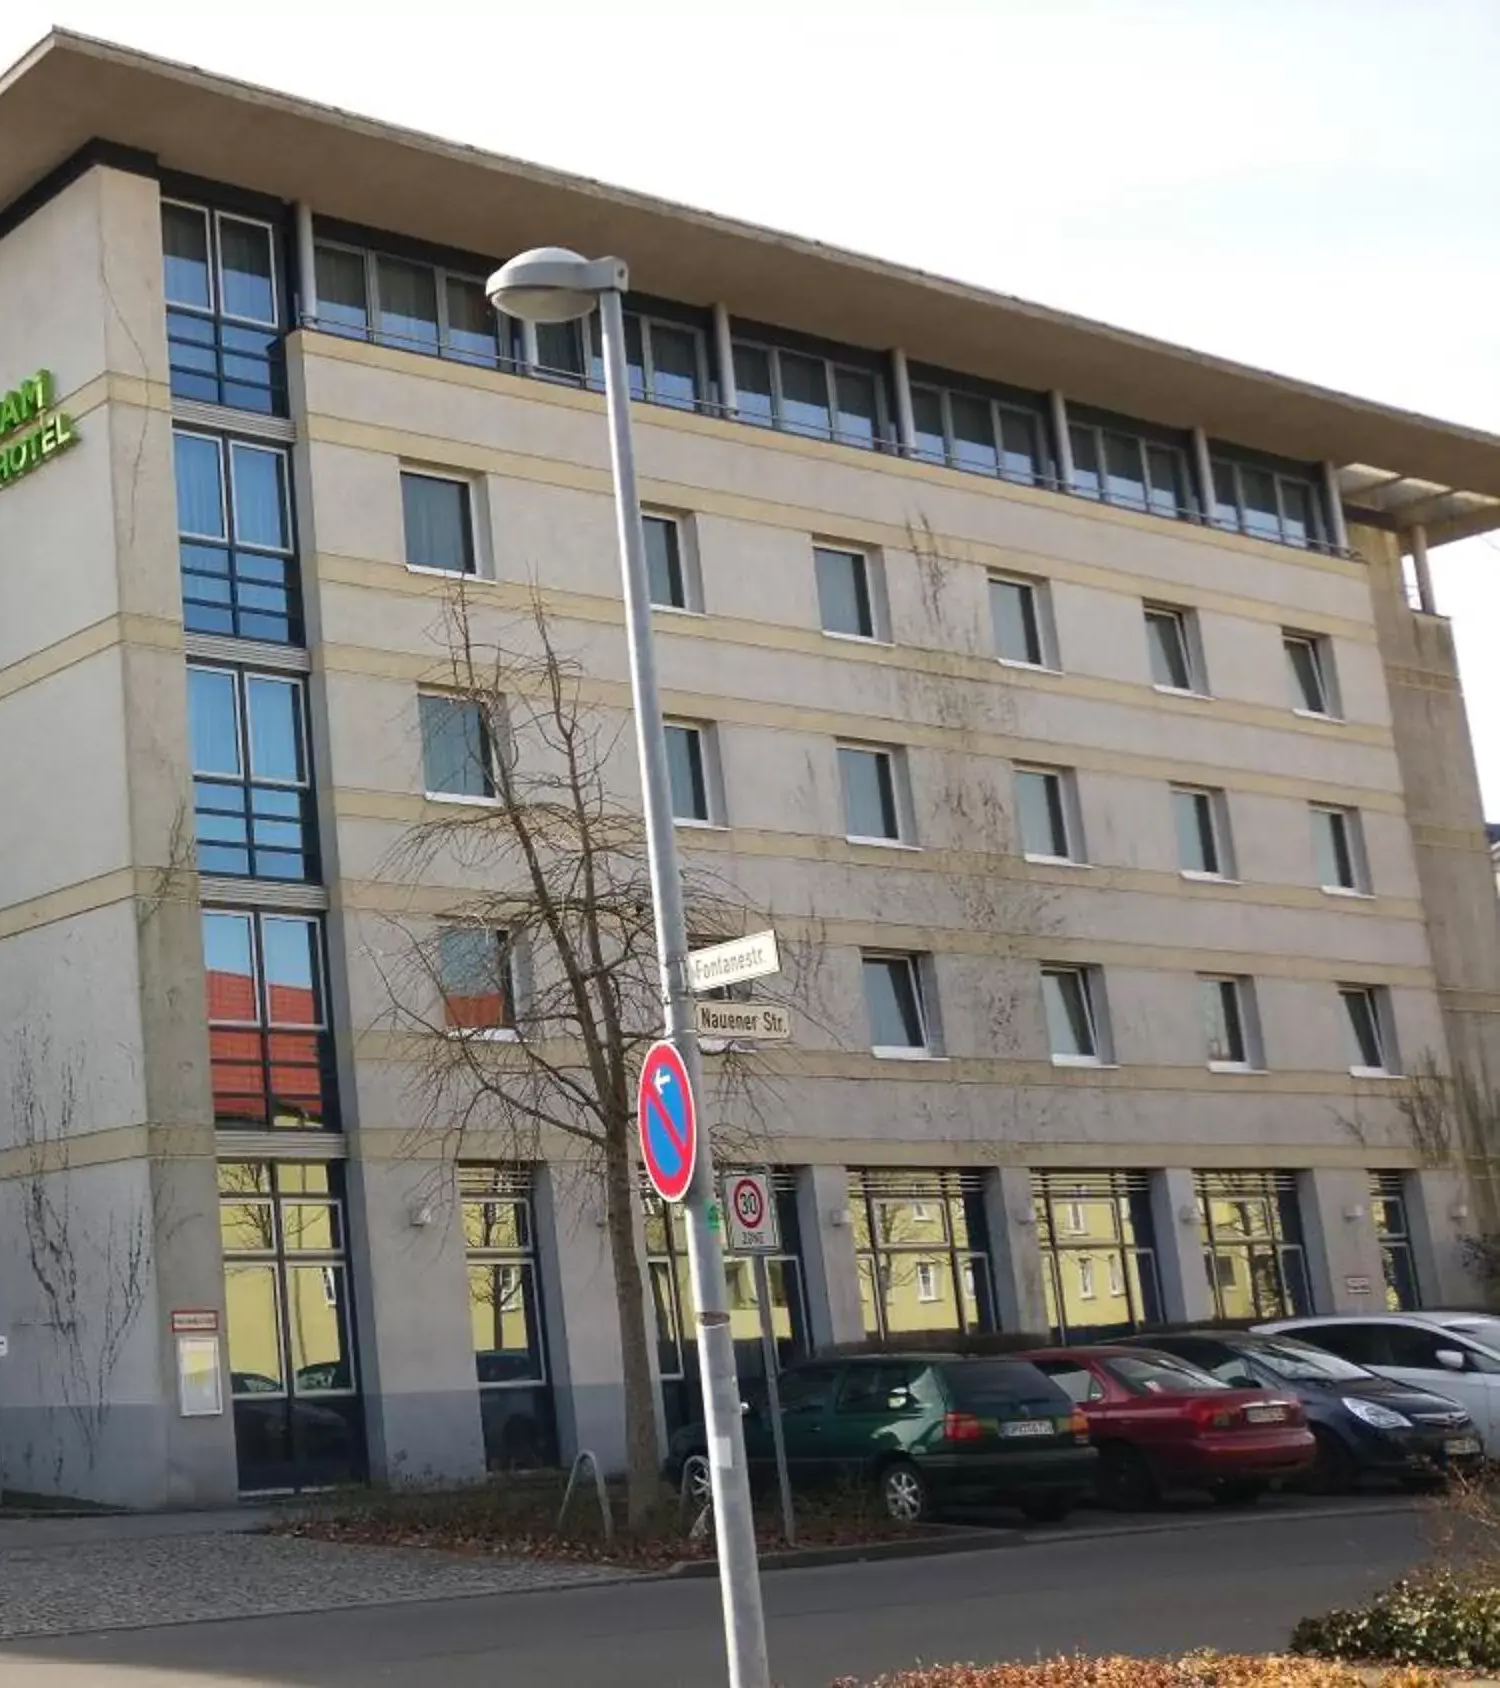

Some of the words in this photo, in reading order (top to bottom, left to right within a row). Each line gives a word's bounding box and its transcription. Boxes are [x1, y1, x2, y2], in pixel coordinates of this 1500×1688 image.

[701, 1007, 758, 1032] Nauener
[763, 1011, 788, 1034] Str.
[740, 1193, 757, 1215] 30
